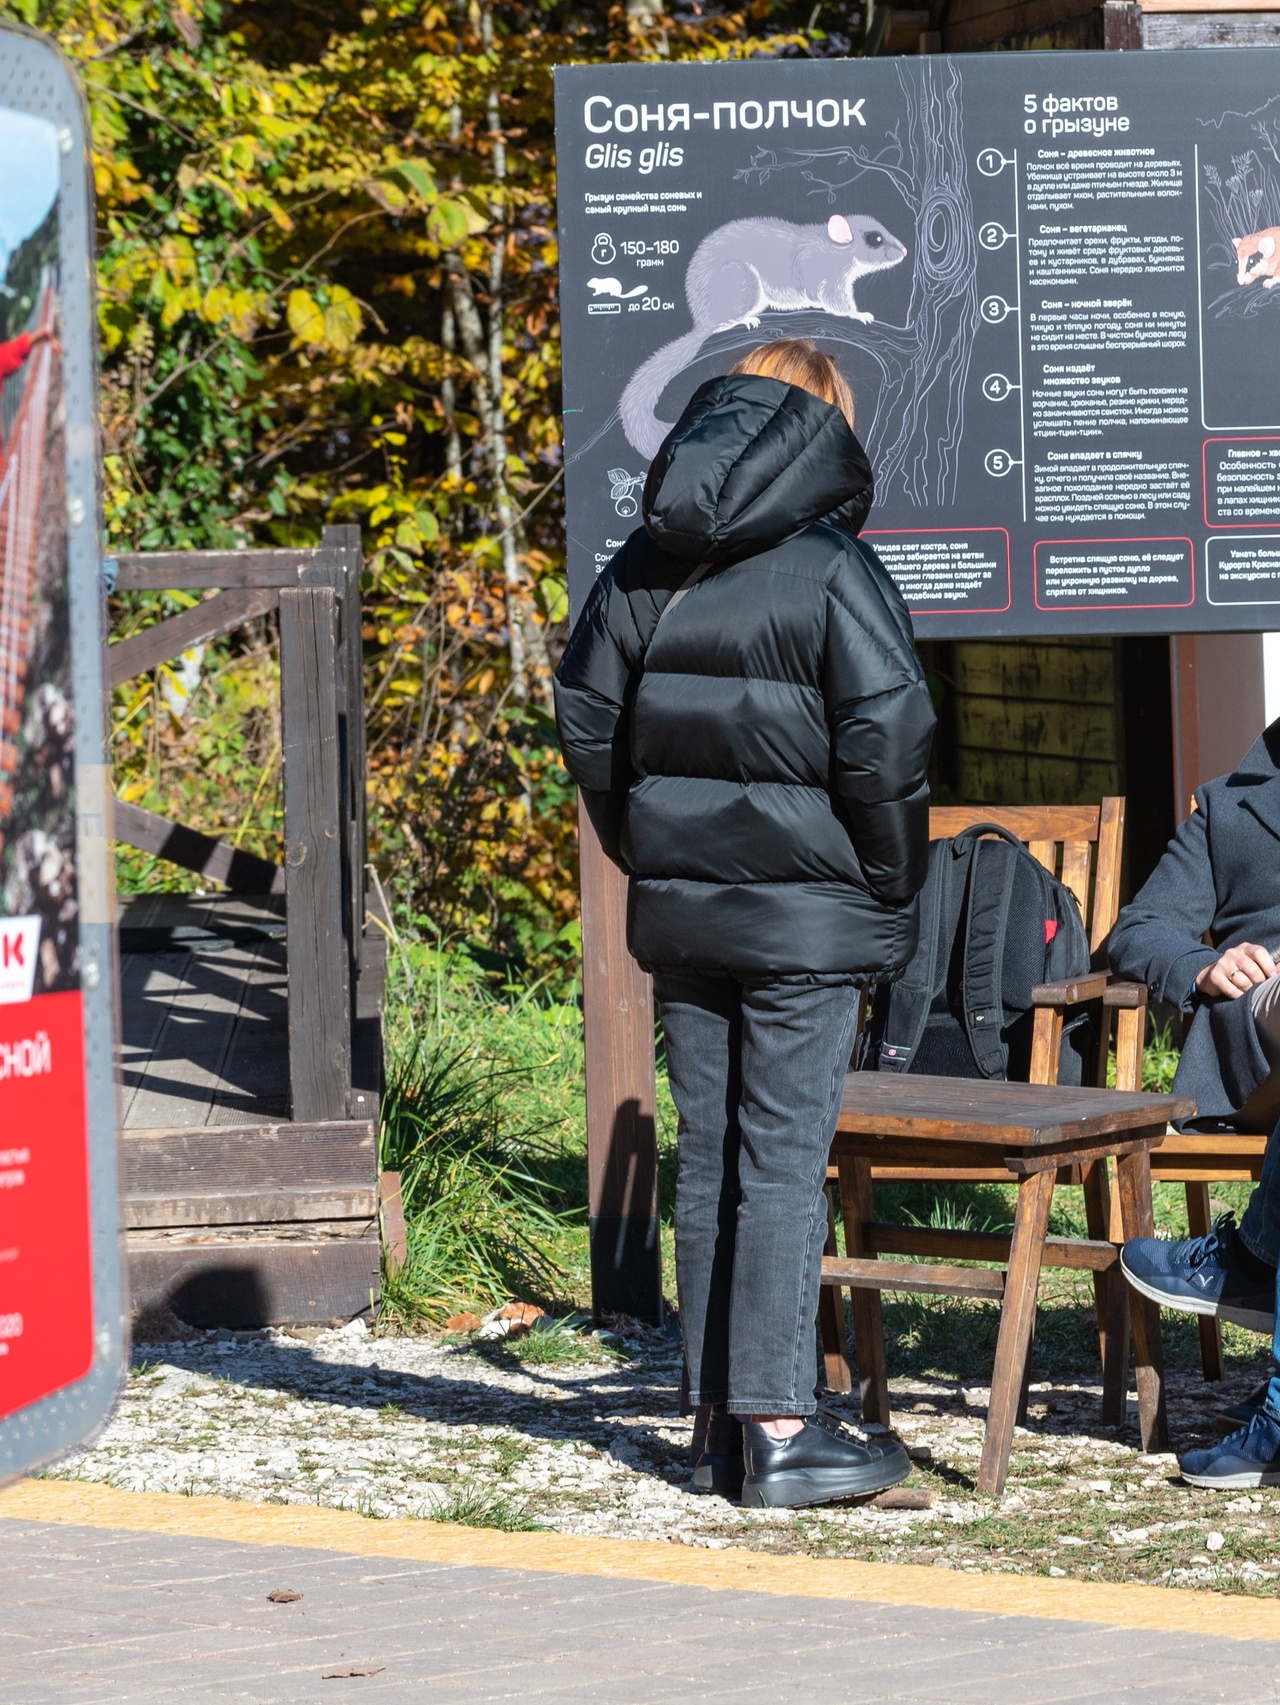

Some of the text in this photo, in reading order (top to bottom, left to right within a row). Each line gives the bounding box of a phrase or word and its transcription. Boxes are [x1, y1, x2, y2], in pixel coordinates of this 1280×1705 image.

[1024, 92, 1118, 118] 5 фактов
[584, 95, 866, 133] Соня-полчок
[1024, 116, 1130, 138] о грызуне
[585, 141, 684, 174] Glis glis
[1037, 149, 1059, 159] Соня
[1067, 149, 1113, 159] древесное
[1114, 148, 1155, 156] животное
[985, 154, 993, 169] 1
[585, 191, 702, 204] Грызун семейства соневых и
[585, 203, 687, 215] самый крупный вид сонь
[1039, 224, 1061, 234] Соня
[1069, 224, 1128, 235] вегетарианец
[986, 228, 998, 243] 2
[636, 258, 664, 269] грамм
[628, 296, 675, 312] до 20 см
[988, 302, 999, 316] 3
[1041, 300, 1063, 309] Соня
[1071, 299, 1102, 309] ночной
[1103, 298, 1133, 309] зверёк
[1043, 363, 1096, 374] Соня издаёт
[989, 379, 1001, 394] 4
[1043, 376, 1121, 386] множество звуков
[1047, 451, 1069, 461] Соня
[1070, 452, 1105, 461] впадает
[1112, 451, 1143, 460] спячку
[1228, 448, 1261, 458] Главное
[993, 455, 1003, 470] 5
[1233, 508, 1244, 516] со
[872, 543, 901, 553] Увидев
[906, 551, 985, 562] забирается на ветви
[1050, 555, 1086, 566] Встретив
[1086, 555, 1118, 565] спящую
[1142, 553, 1152, 562] её
[1152, 553, 1184, 563] следует
[1230, 550, 1257, 558] Узнать
[922, 563, 950, 572] дерева
[957, 560, 997, 569] большими
[1045, 567, 1092, 576] переложить
[1099, 566, 1126, 575] пустое
[1126, 565, 1151, 574] дупло
[1219, 561, 1251, 571] Курорта
[922, 571, 992, 580] глазами следит за
[1230, 572, 1270, 581] экскурсии
[905, 583, 933, 591] иногда
[933, 582, 954, 590] даже
[955, 580, 982, 590] издаёт
[1061, 577, 1100, 587] укромную
[1101, 576, 1137, 586] развилку
[1046, 588, 1077, 598] спрятав
